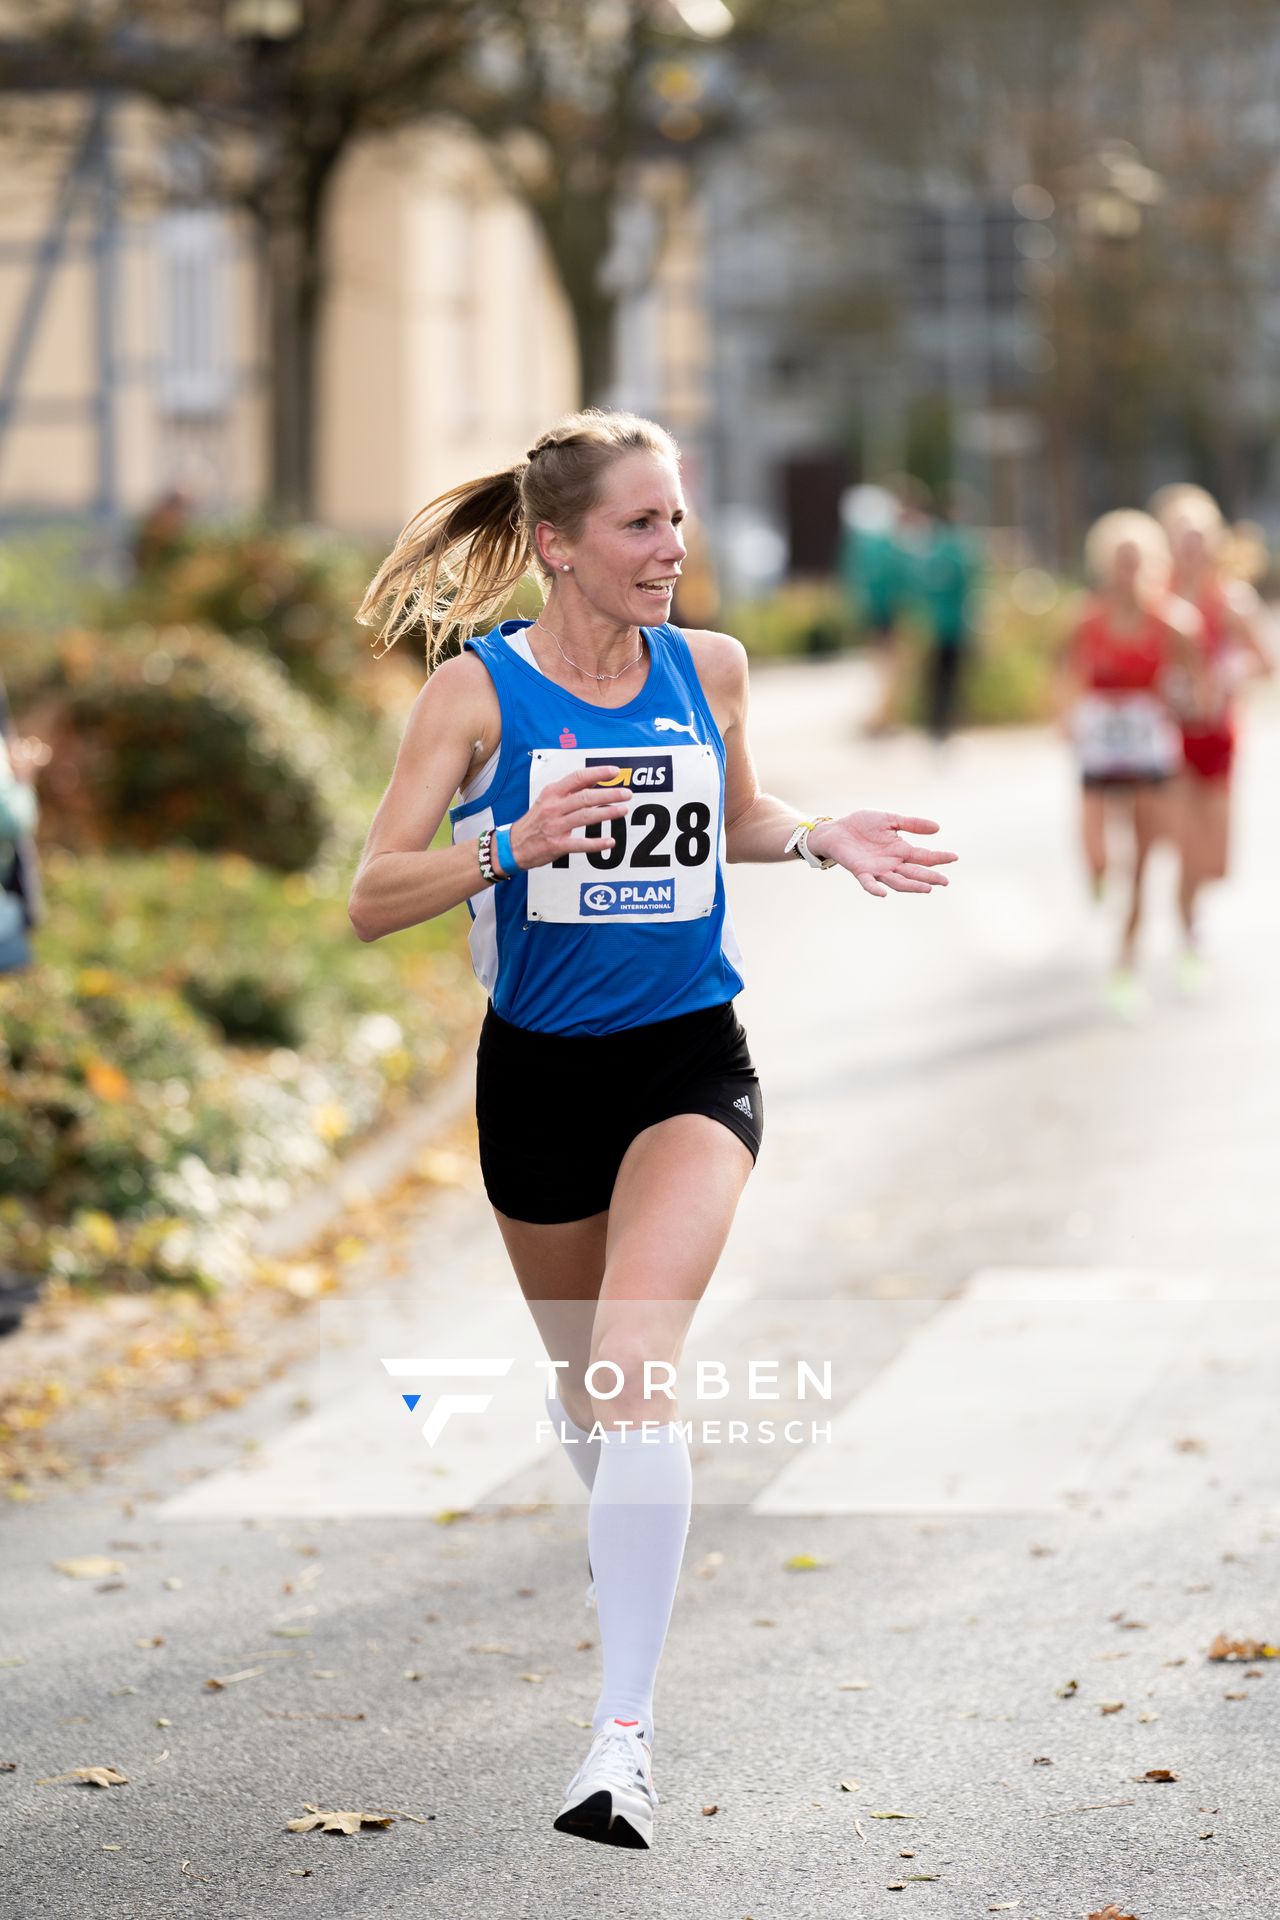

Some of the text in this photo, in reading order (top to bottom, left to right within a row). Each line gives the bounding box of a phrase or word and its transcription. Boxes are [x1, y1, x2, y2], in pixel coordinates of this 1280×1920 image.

[632, 766, 666, 786] GLS
[551, 802, 711, 870] 028
[620, 886, 672, 902] PLAN
